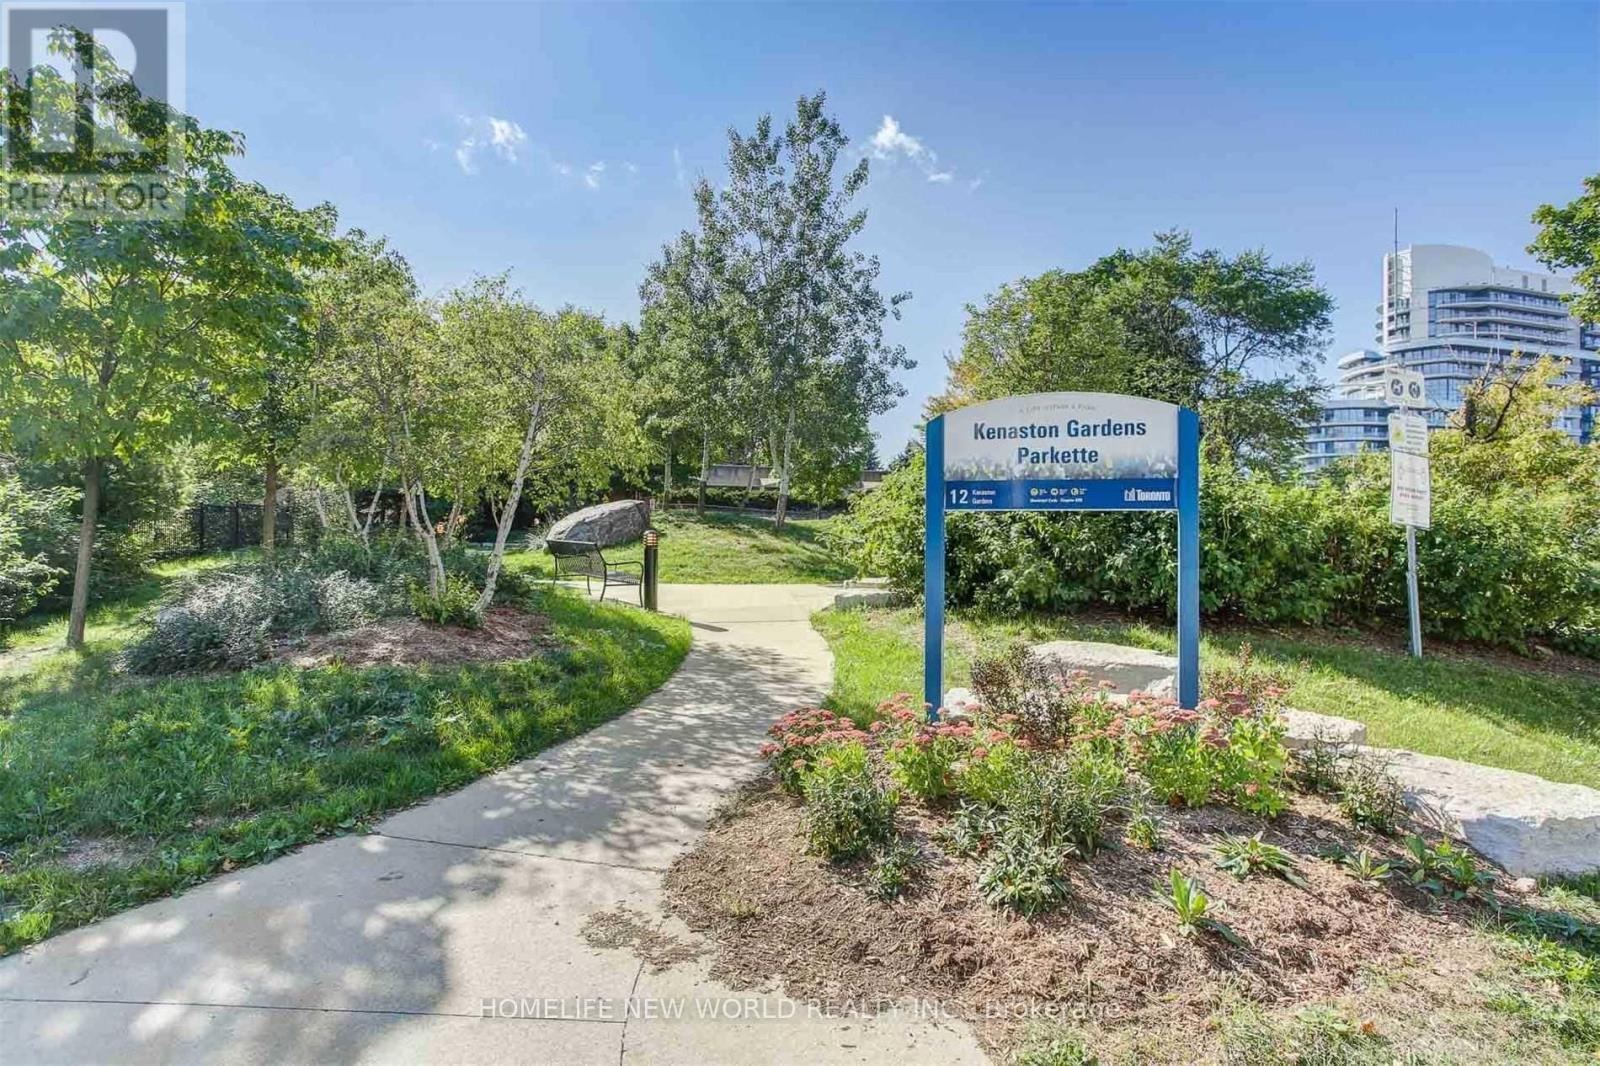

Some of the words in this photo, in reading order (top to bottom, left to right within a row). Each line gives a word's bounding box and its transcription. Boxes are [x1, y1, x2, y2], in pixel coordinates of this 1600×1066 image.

[974, 422, 1059, 440] Kenaston
[1067, 419, 1147, 437] Gardens
[1017, 446, 1099, 465] Parkette
[950, 489, 969, 504] 12
